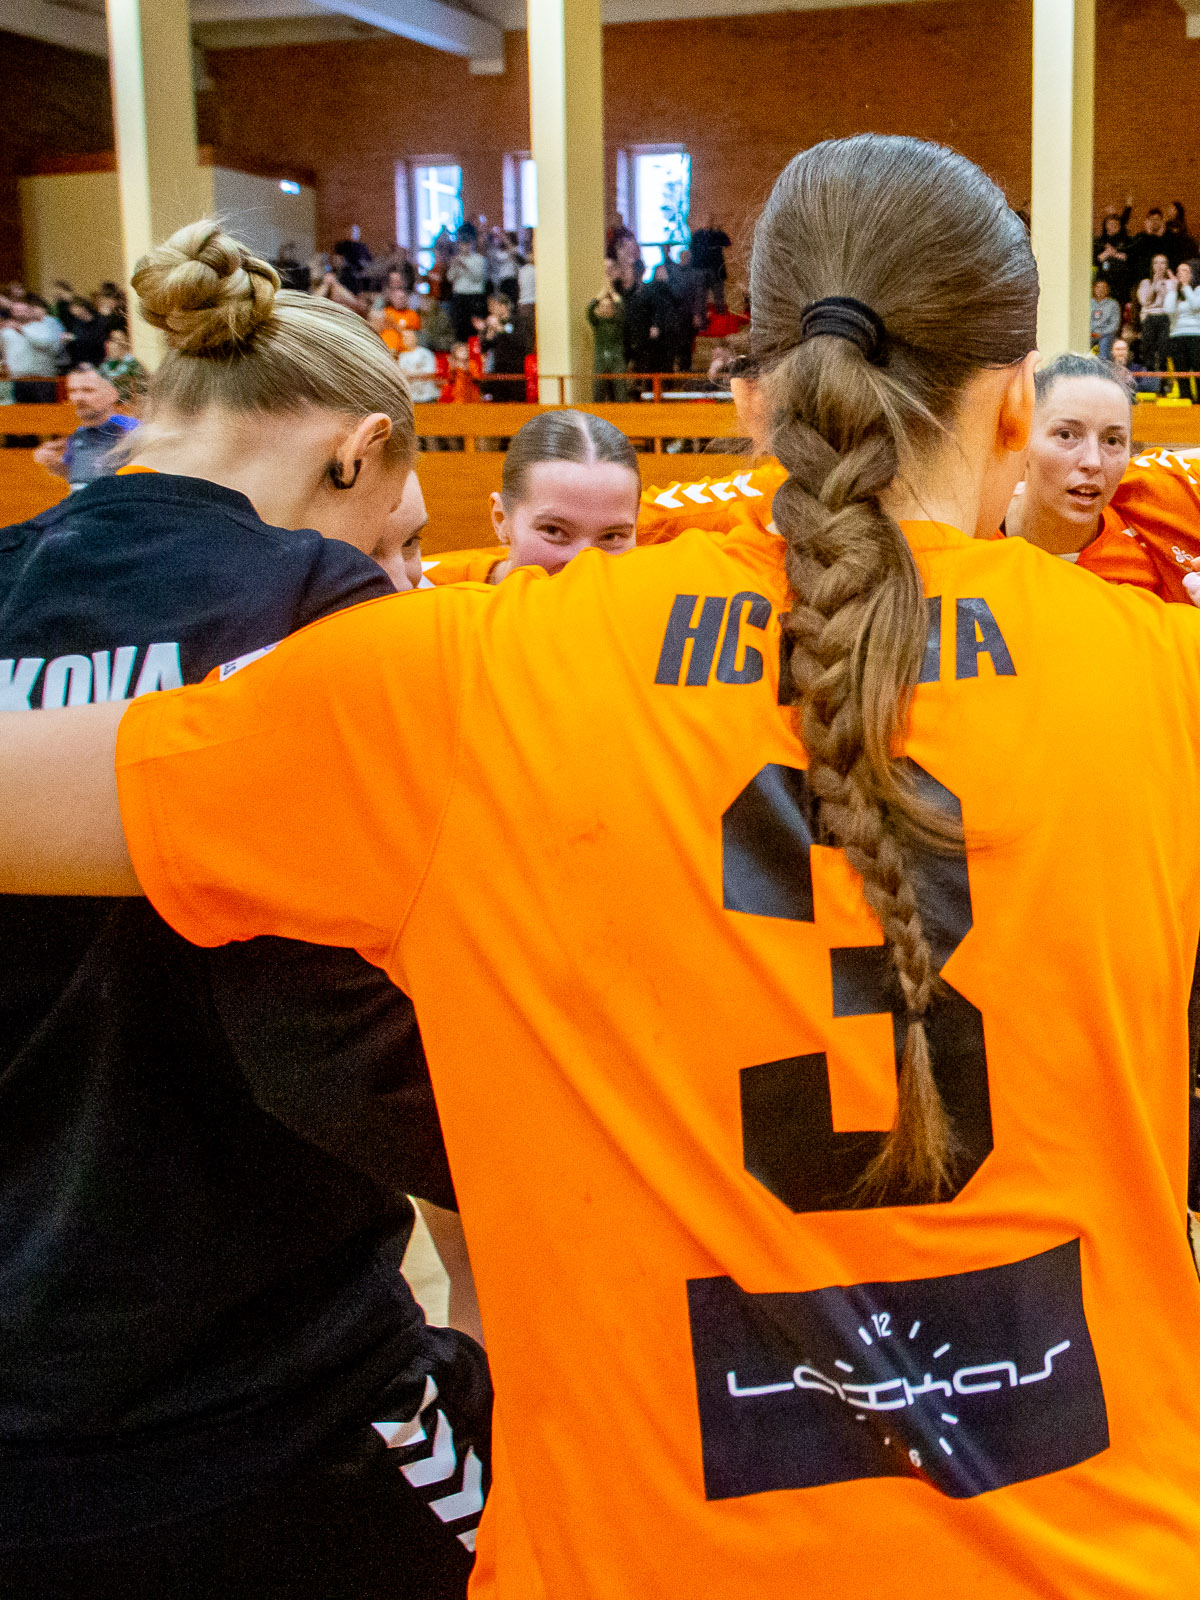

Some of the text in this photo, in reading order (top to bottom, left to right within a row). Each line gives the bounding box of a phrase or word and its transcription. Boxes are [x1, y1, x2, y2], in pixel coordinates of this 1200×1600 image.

[0, 642, 184, 710] KOVA
[654, 590, 772, 687] HC
[722, 756, 994, 1214] 3
[871, 1312, 891, 1337] 12
